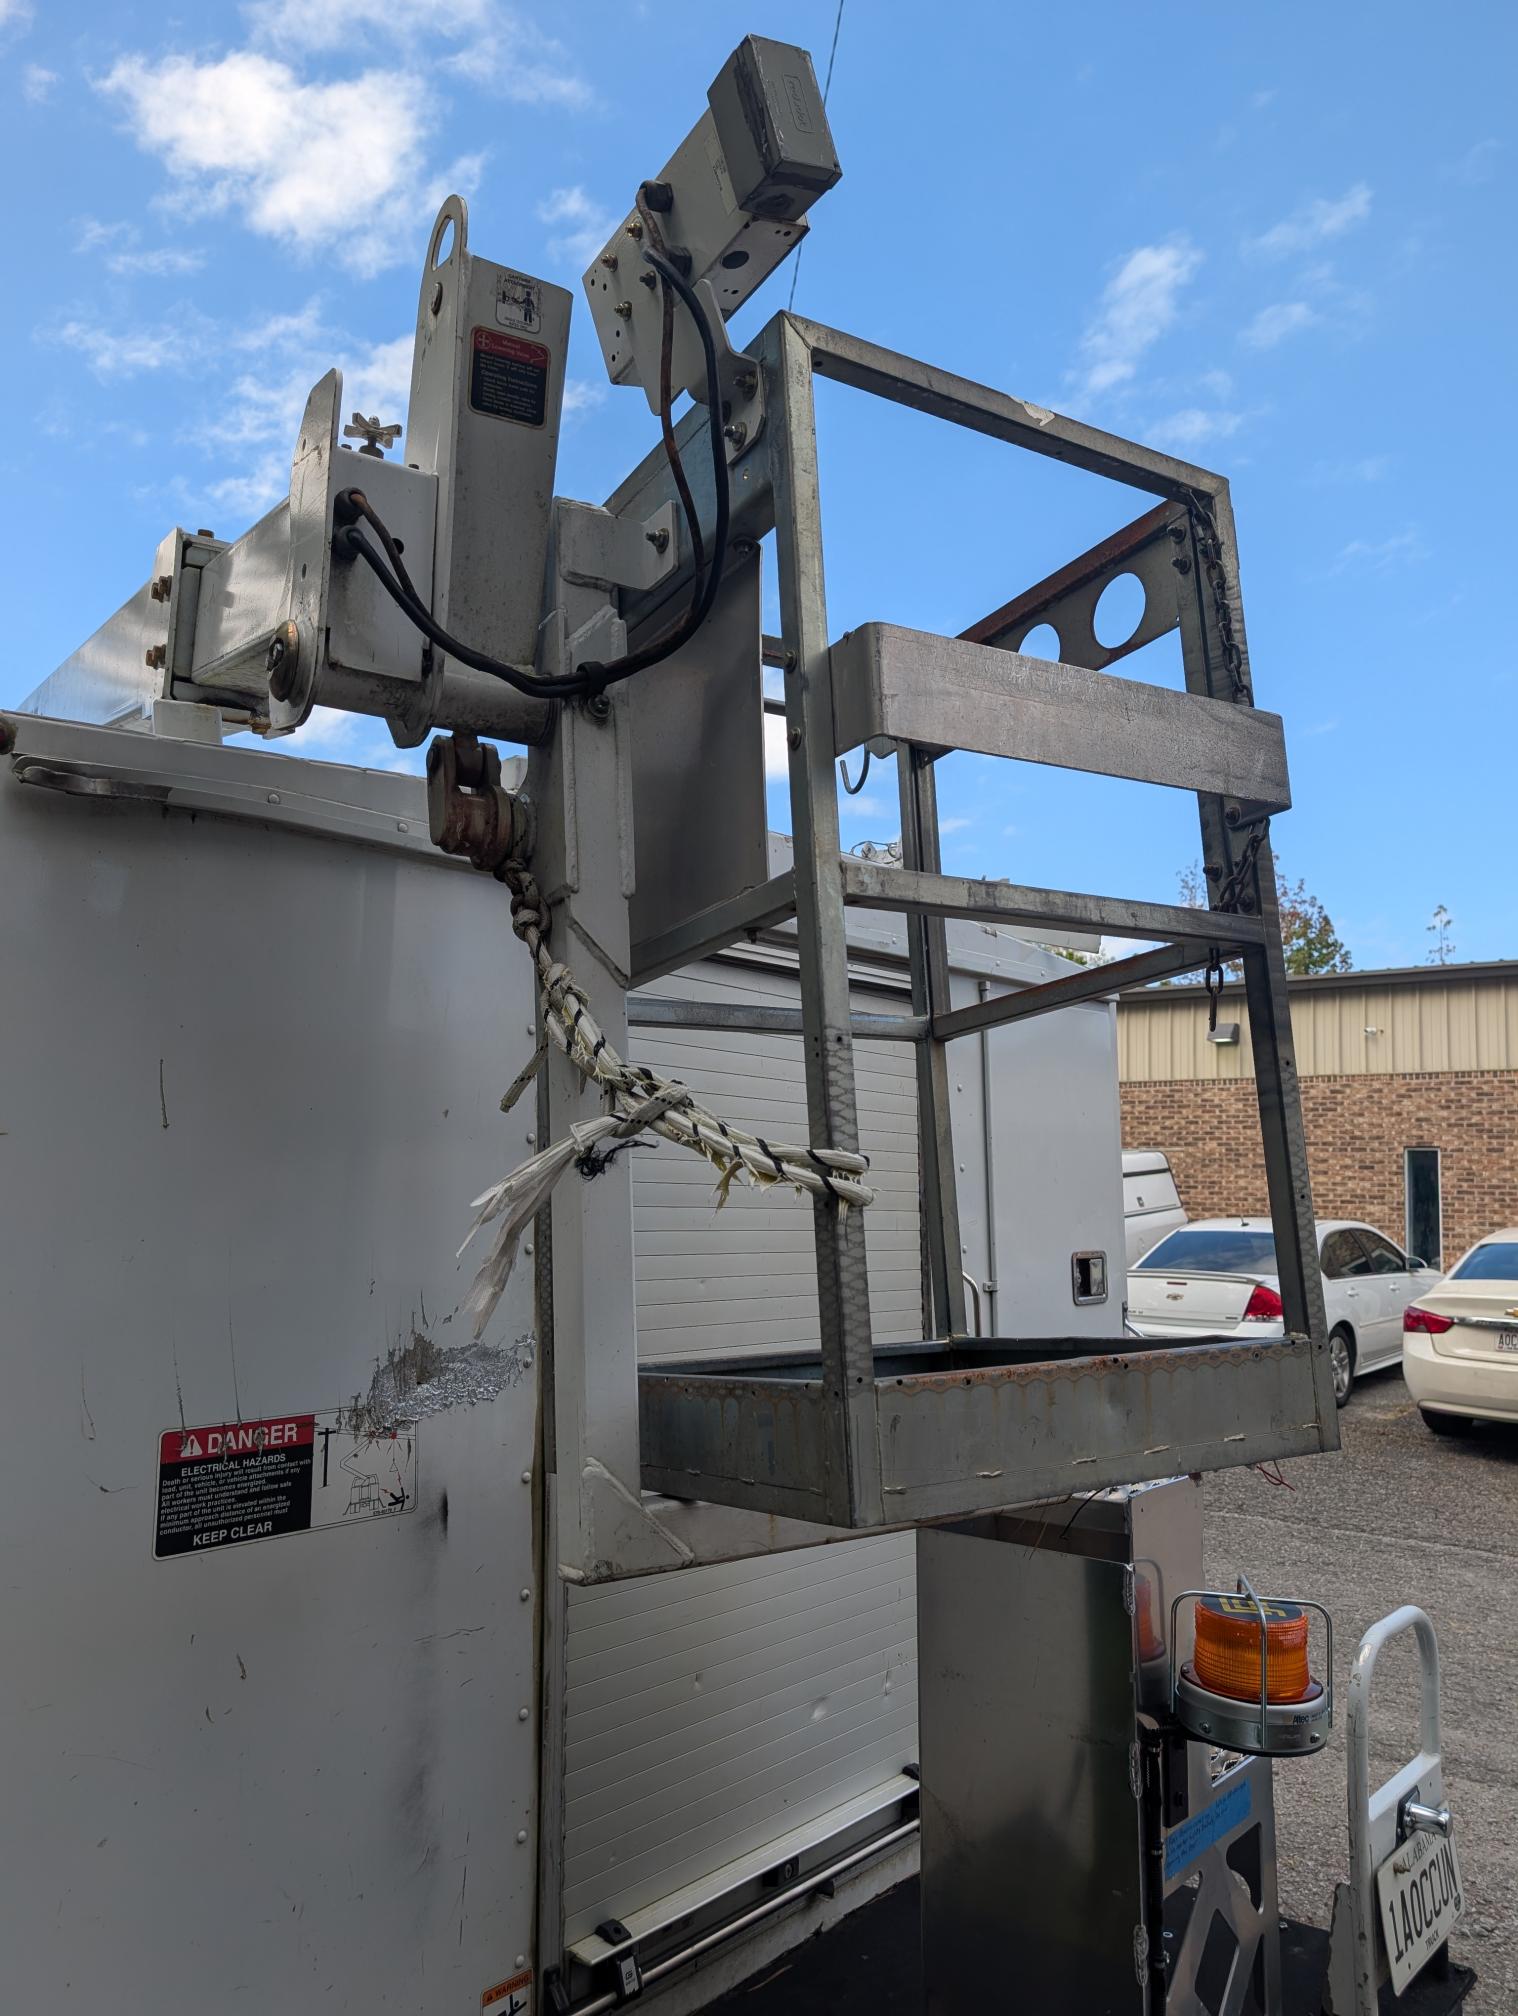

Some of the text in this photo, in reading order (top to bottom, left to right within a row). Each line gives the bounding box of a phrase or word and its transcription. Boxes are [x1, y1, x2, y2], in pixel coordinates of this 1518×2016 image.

[207, 1423, 298, 1453] DANGER
[181, 1454, 286, 1476] ELECTRICAL HAZARDS
[161, 1493, 174, 1501] part
[208, 1483, 235, 1492] becomes
[237, 1479, 266, 1489] energized.
[162, 1478, 180, 1486] Death
[190, 1474, 213, 1482] serious
[214, 1471, 232, 1480] injury
[162, 1486, 177, 1494] load,
[178, 1483, 191, 1491] unit,
[194, 1480, 216, 1489] vehicle,
[227, 1475, 247, 1483] vehicle
[249, 1469, 283, 1479] attachments
[160, 1505, 189, 1514] electrical
[207, 1497, 237, 1507] practices.
[171, 1496, 196, 1505] workers
[214, 1488, 247, 1498] understand
[160, 1519, 189, 1528] minimum
[190, 1513, 219, 1525] approach
[220, 1509, 245, 1518] distance
[262, 1501, 290, 1511] energized
[179, 1511, 192, 1519] part
[232, 1500, 257, 1509] elevated
[159, 1525, 193, 1536] conductor,
[203, 1516, 242, 1527] unauthorized
[243, 1511, 272, 1521] personnel
[193, 1521, 272, 1546] KEEP CLEAR
[1425, 1927, 1440, 1951] TRUCK
[495, 1974, 529, 1997] WARNING
